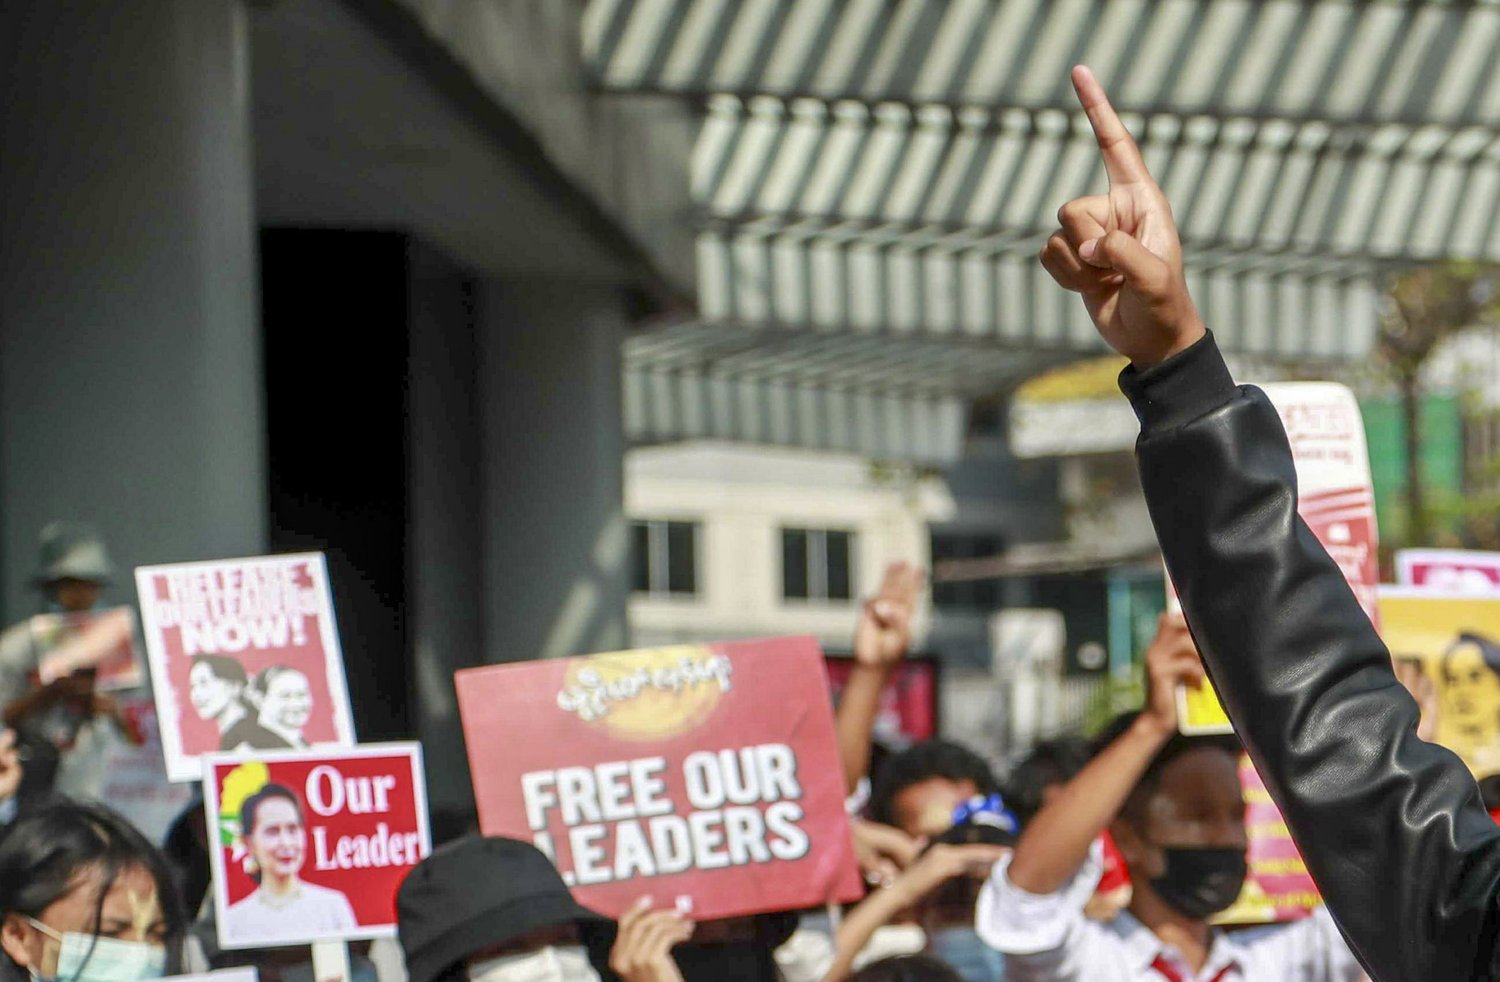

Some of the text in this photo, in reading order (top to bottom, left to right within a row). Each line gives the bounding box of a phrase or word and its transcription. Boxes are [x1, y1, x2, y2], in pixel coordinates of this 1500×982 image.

[181, 614, 307, 655] NOW!
[305, 765, 396, 816] Our
[522, 743, 802, 830] FREE OUR
[311, 821, 420, 871] Leader
[533, 802, 810, 886] LEADERS
